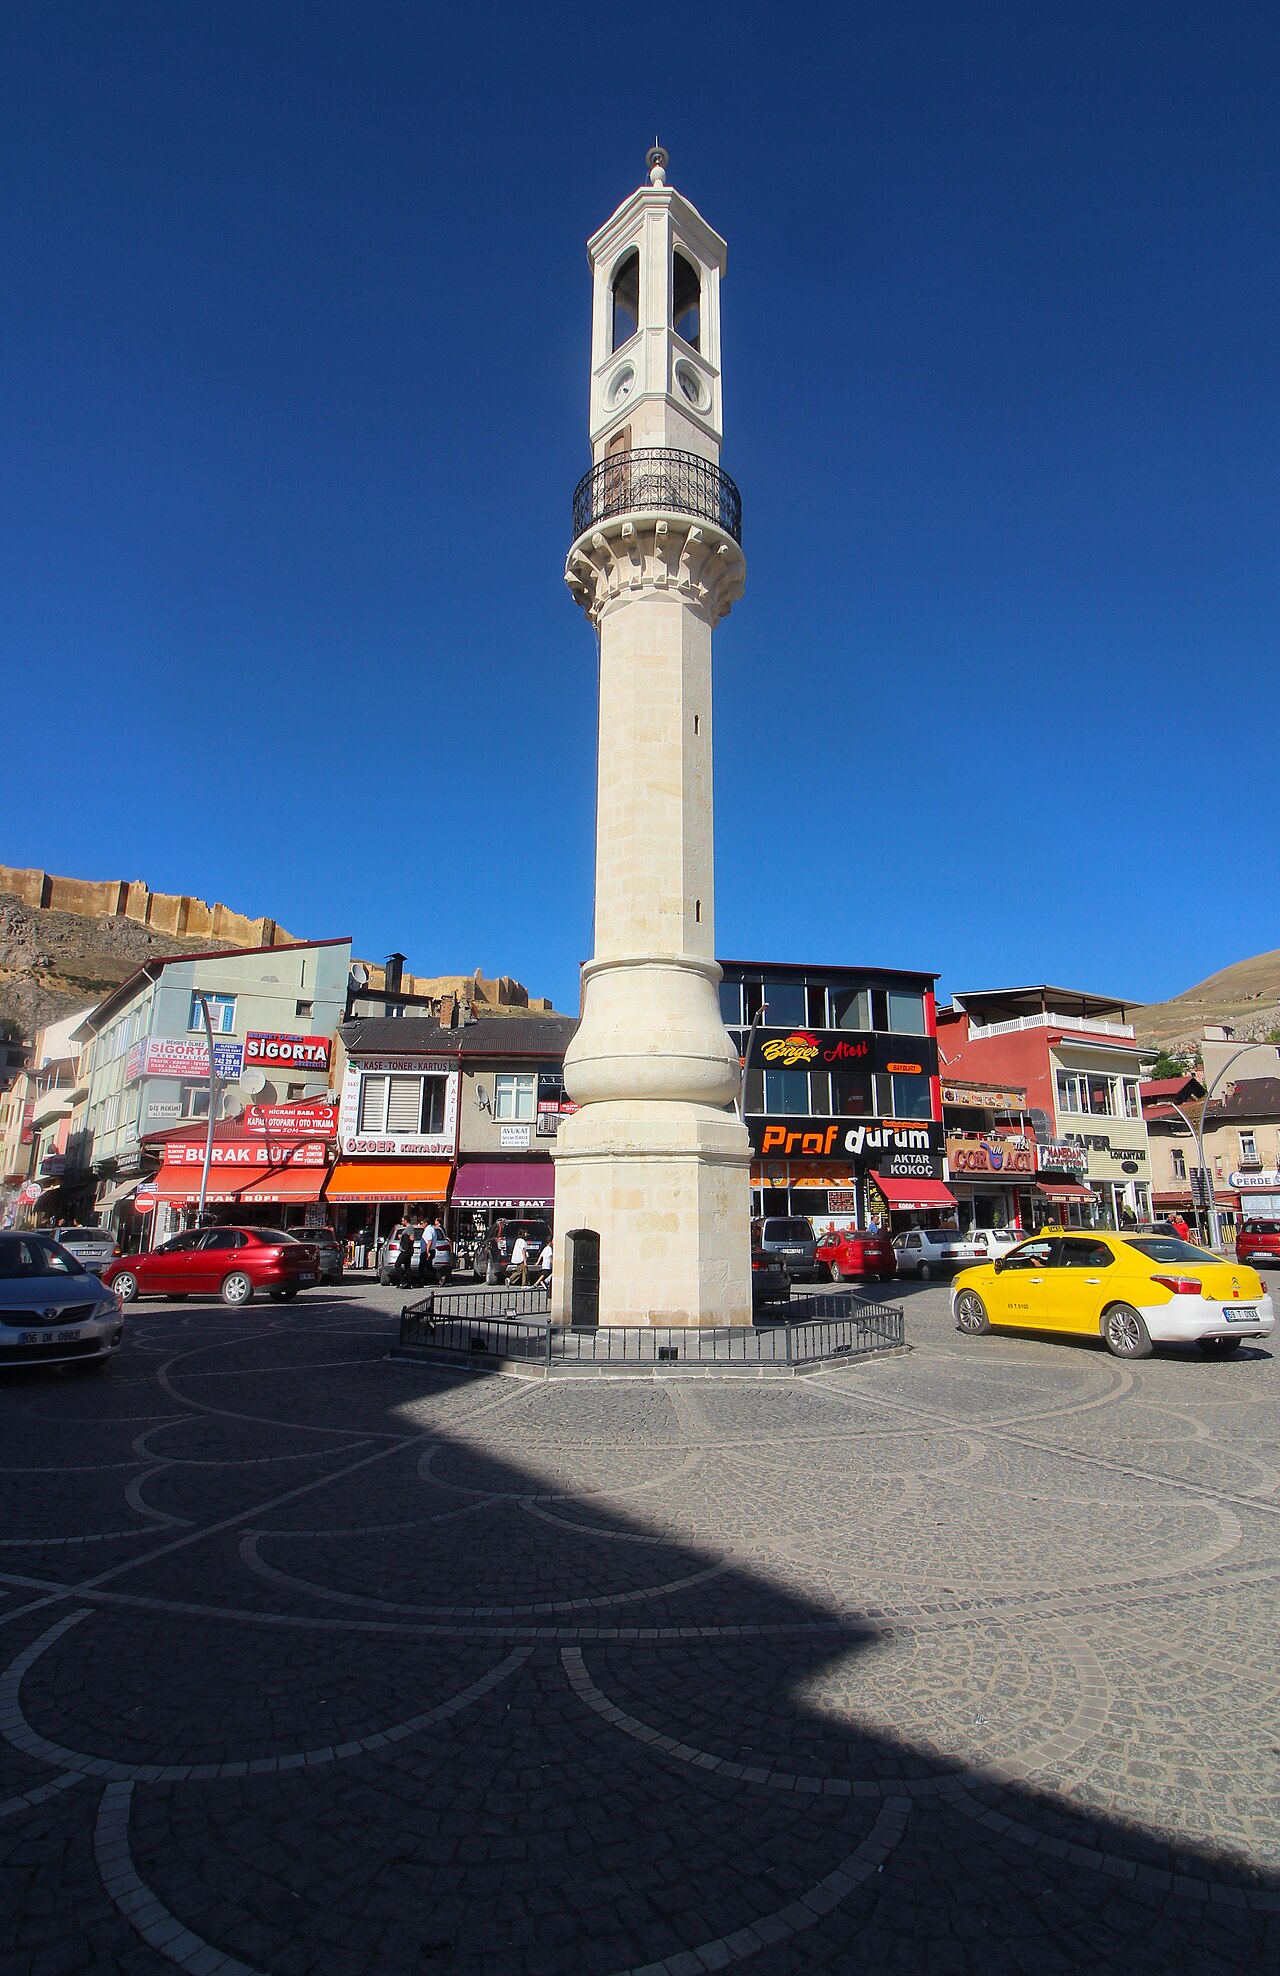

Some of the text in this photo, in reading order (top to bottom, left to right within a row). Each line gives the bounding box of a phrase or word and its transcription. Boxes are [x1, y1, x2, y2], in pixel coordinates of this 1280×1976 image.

[151, 1042, 210, 1055] SİGORTA
[247, 1039, 327, 1061] SİGORTA
[363, 1061, 382, 1071] KAŞE
[388, 1061, 413, 1070] TONER
[418, 1062, 447, 1072] KARTUŞ
[268, 1118, 295, 1127] OTOPARK
[299, 1119, 311, 1127] OTO
[312, 1119, 334, 1128] YIKAMA
[347, 1138, 453, 1153] ÖZGER KIRTASİYE
[762, 1125, 930, 1155] Prof dürüm
[185, 1146, 305, 1162] BURAK BÜFE
[893, 1154, 930, 1164] AKTAR
[890, 1165, 933, 1177] KOKOÇ
[1236, 1177, 1272, 1186] PERDE
[244, 1193, 279, 1203] BÜFE
[459, 1199, 513, 1207] TUHAFİYE
[26, 1333, 38, 1344] 06
[43, 1332, 54, 1343] DK
